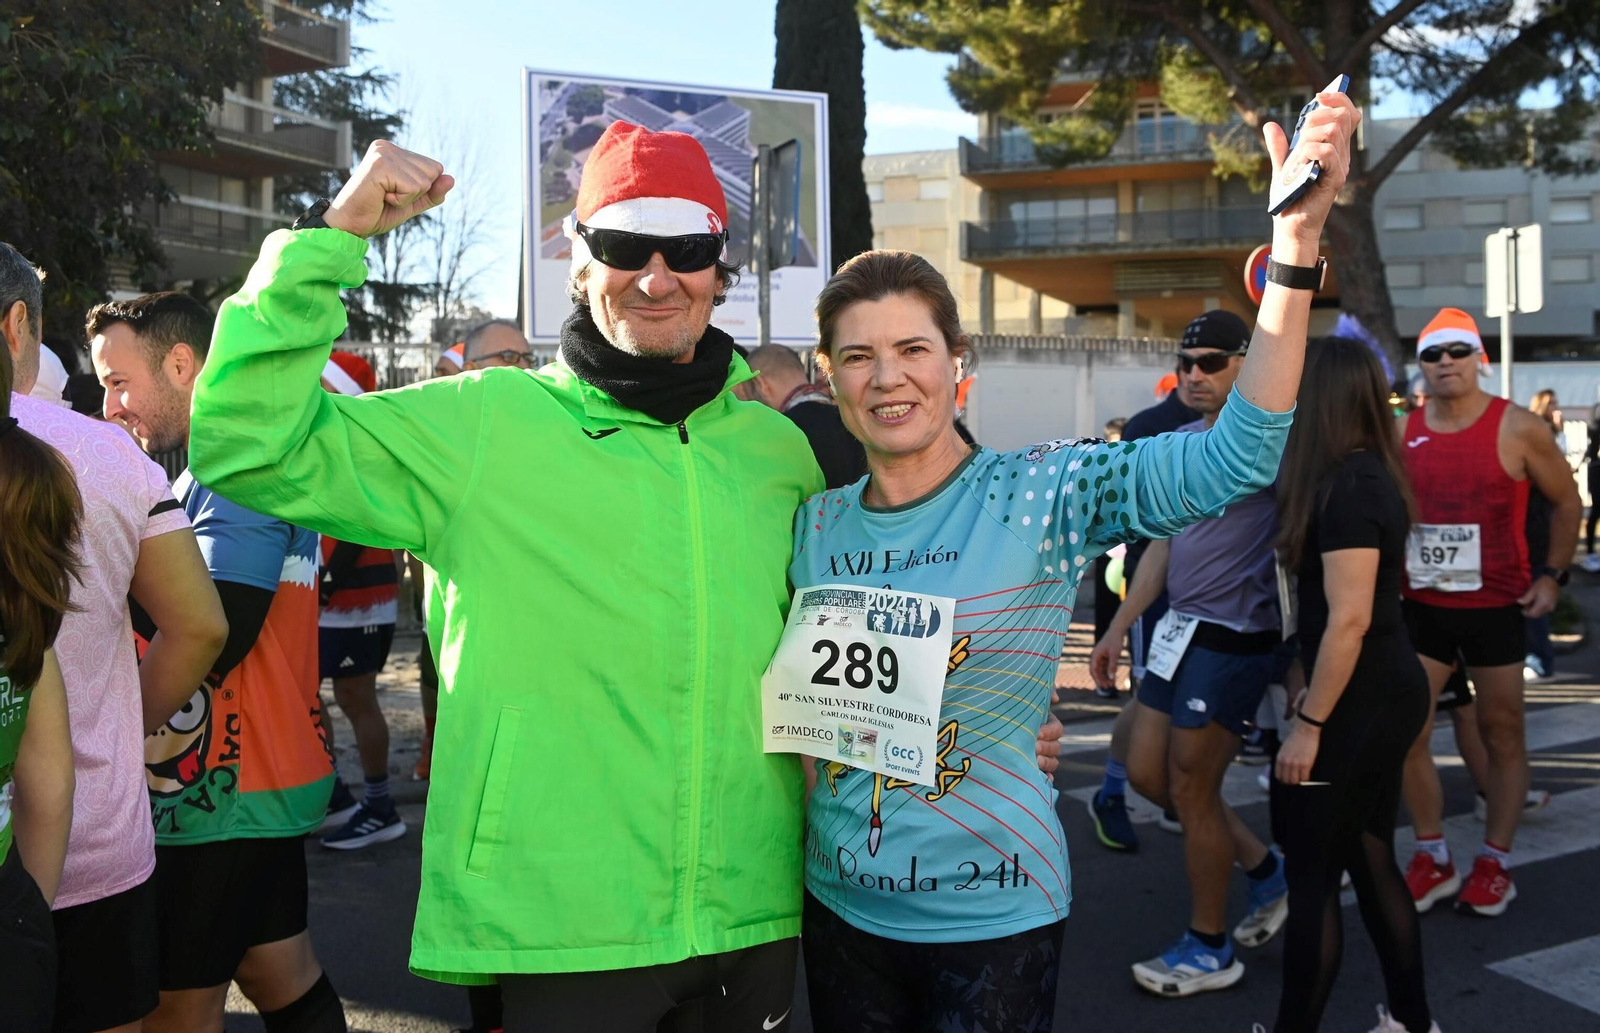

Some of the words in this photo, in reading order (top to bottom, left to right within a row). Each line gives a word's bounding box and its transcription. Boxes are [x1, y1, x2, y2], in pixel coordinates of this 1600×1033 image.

[821, 551, 873, 577] XXII
[882, 545, 958, 574] Edición
[1421, 546, 1459, 565] 697
[820, 589, 856, 599] PROVINCIAL
[858, 592, 866, 600] DE
[823, 597, 866, 609] POPULARES
[868, 592, 908, 613] 2024
[811, 639, 899, 694] 289
[795, 693, 816, 704] SAN
[818, 697, 875, 713] SILVESTRE
[877, 705, 932, 726] CORDOBESA
[821, 710, 849, 720] CARLOS
[851, 715, 867, 724] DIAZ
[868, 718, 894, 730] IGLESIAS
[787, 725, 833, 741] IMDECO
[892, 746, 915, 760] GCC
[886, 763, 900, 771] SPORT
[901, 767, 920, 776] EVENTS
[837, 846, 938, 893] Ronda
[954, 853, 1029, 891] 24h
